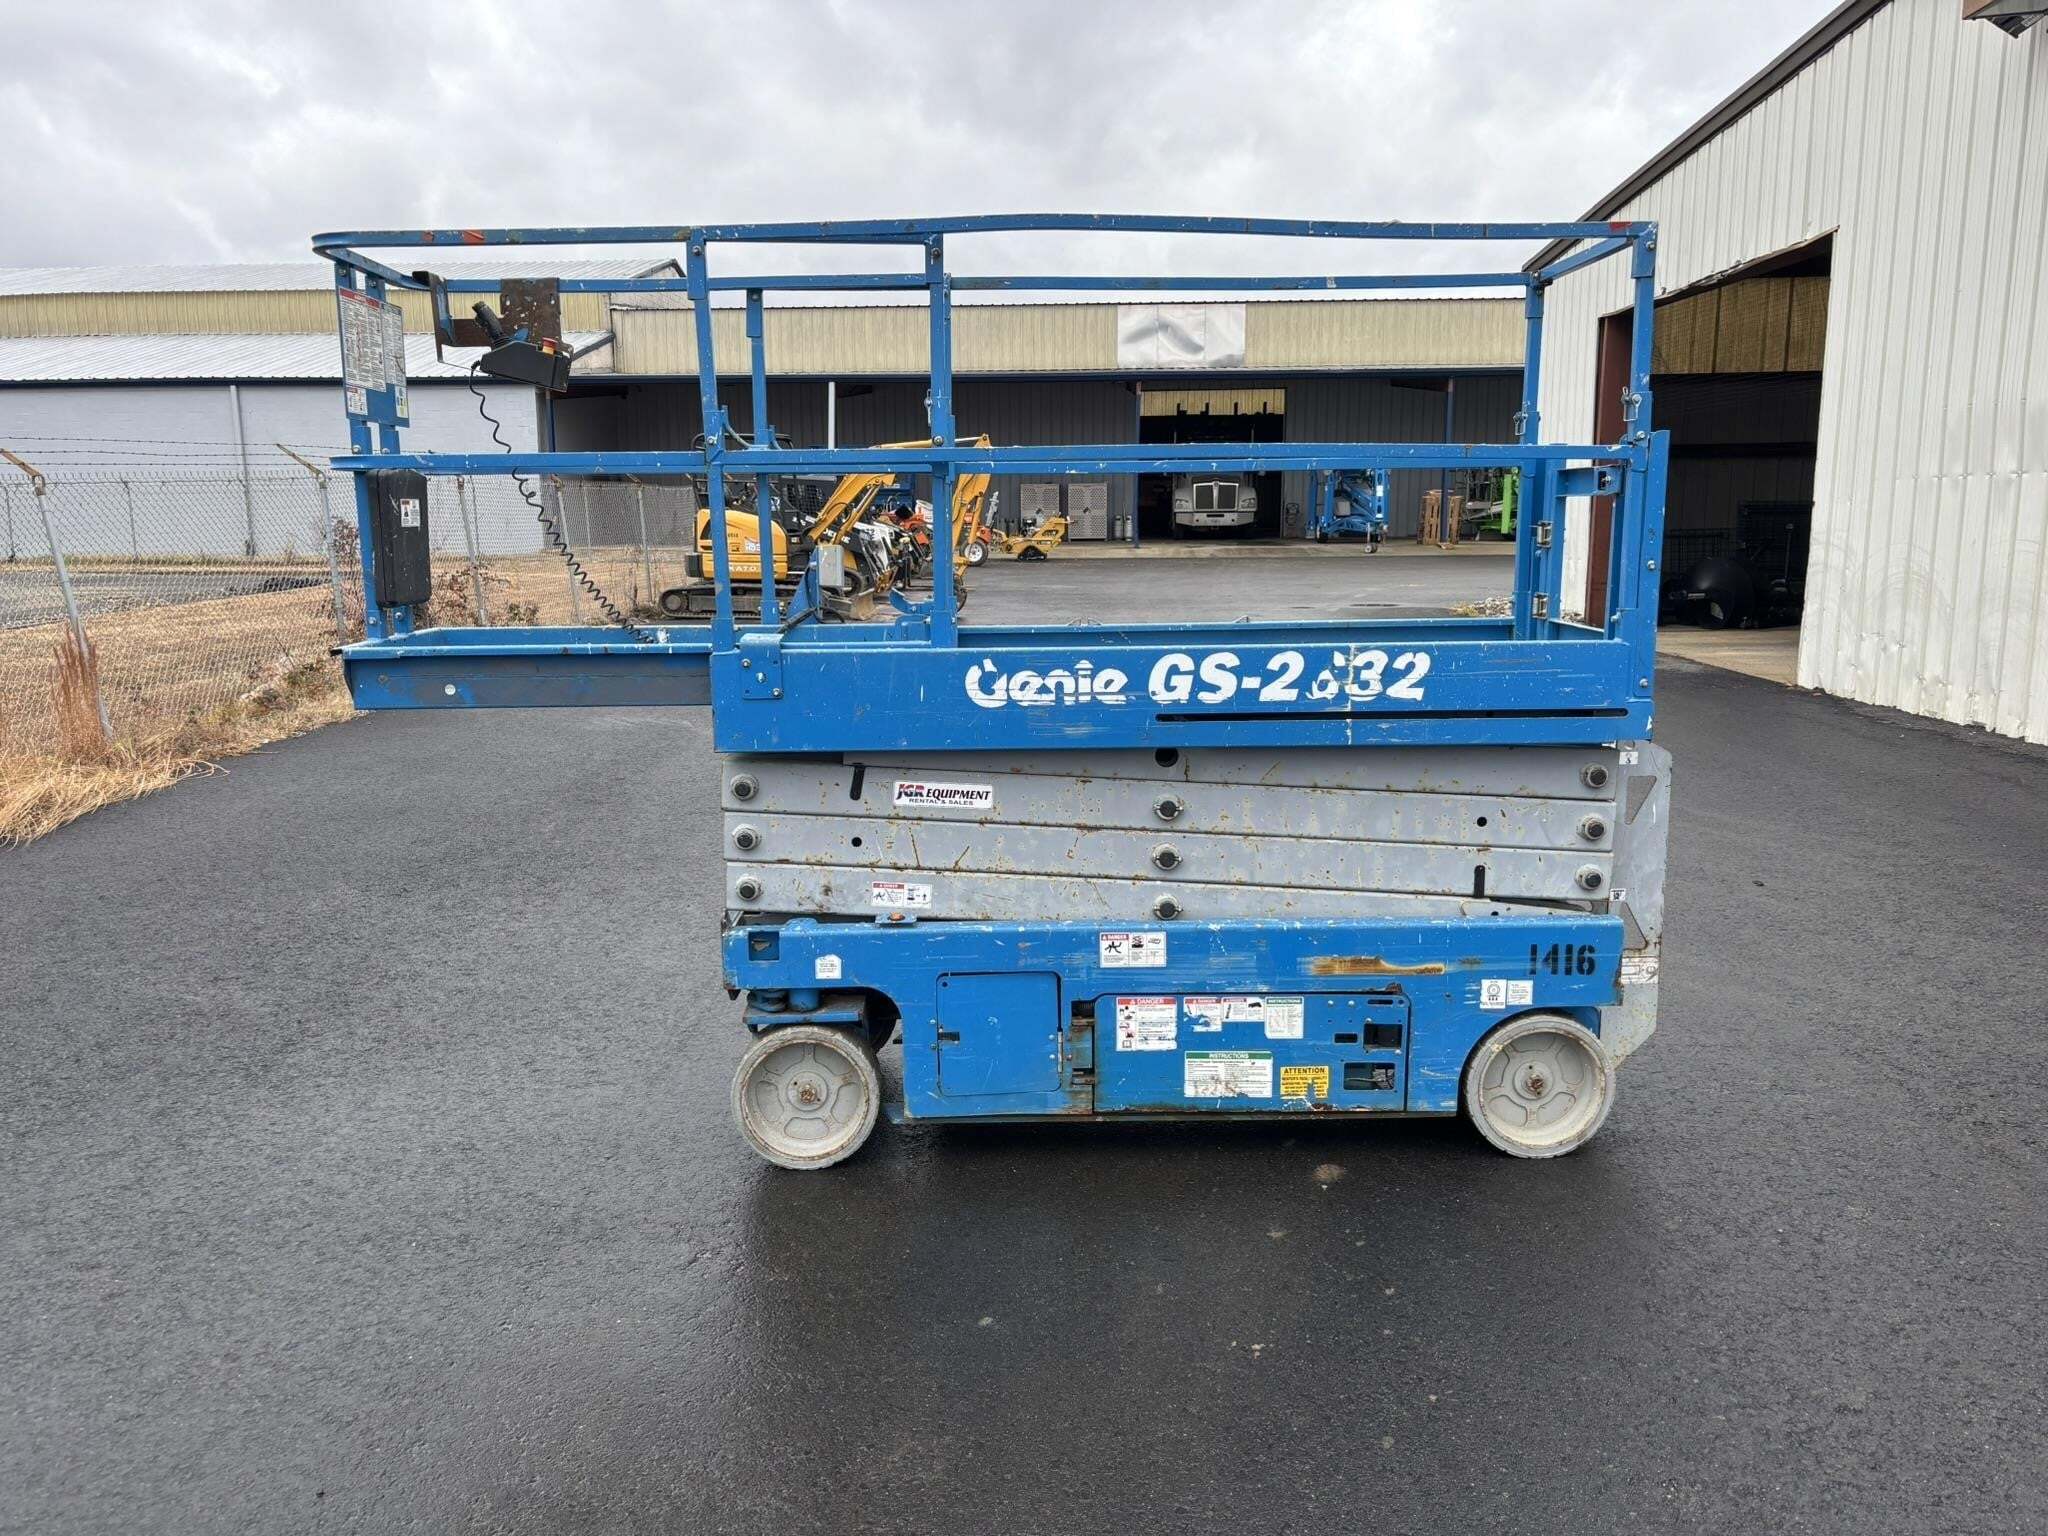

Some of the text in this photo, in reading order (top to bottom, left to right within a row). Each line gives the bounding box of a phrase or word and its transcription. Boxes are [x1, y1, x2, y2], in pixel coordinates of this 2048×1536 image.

[965, 658, 1129, 708] Genie
[896, 784, 991, 801] JGR EQUIPMENT
[1529, 943, 1595, 976] 1416
